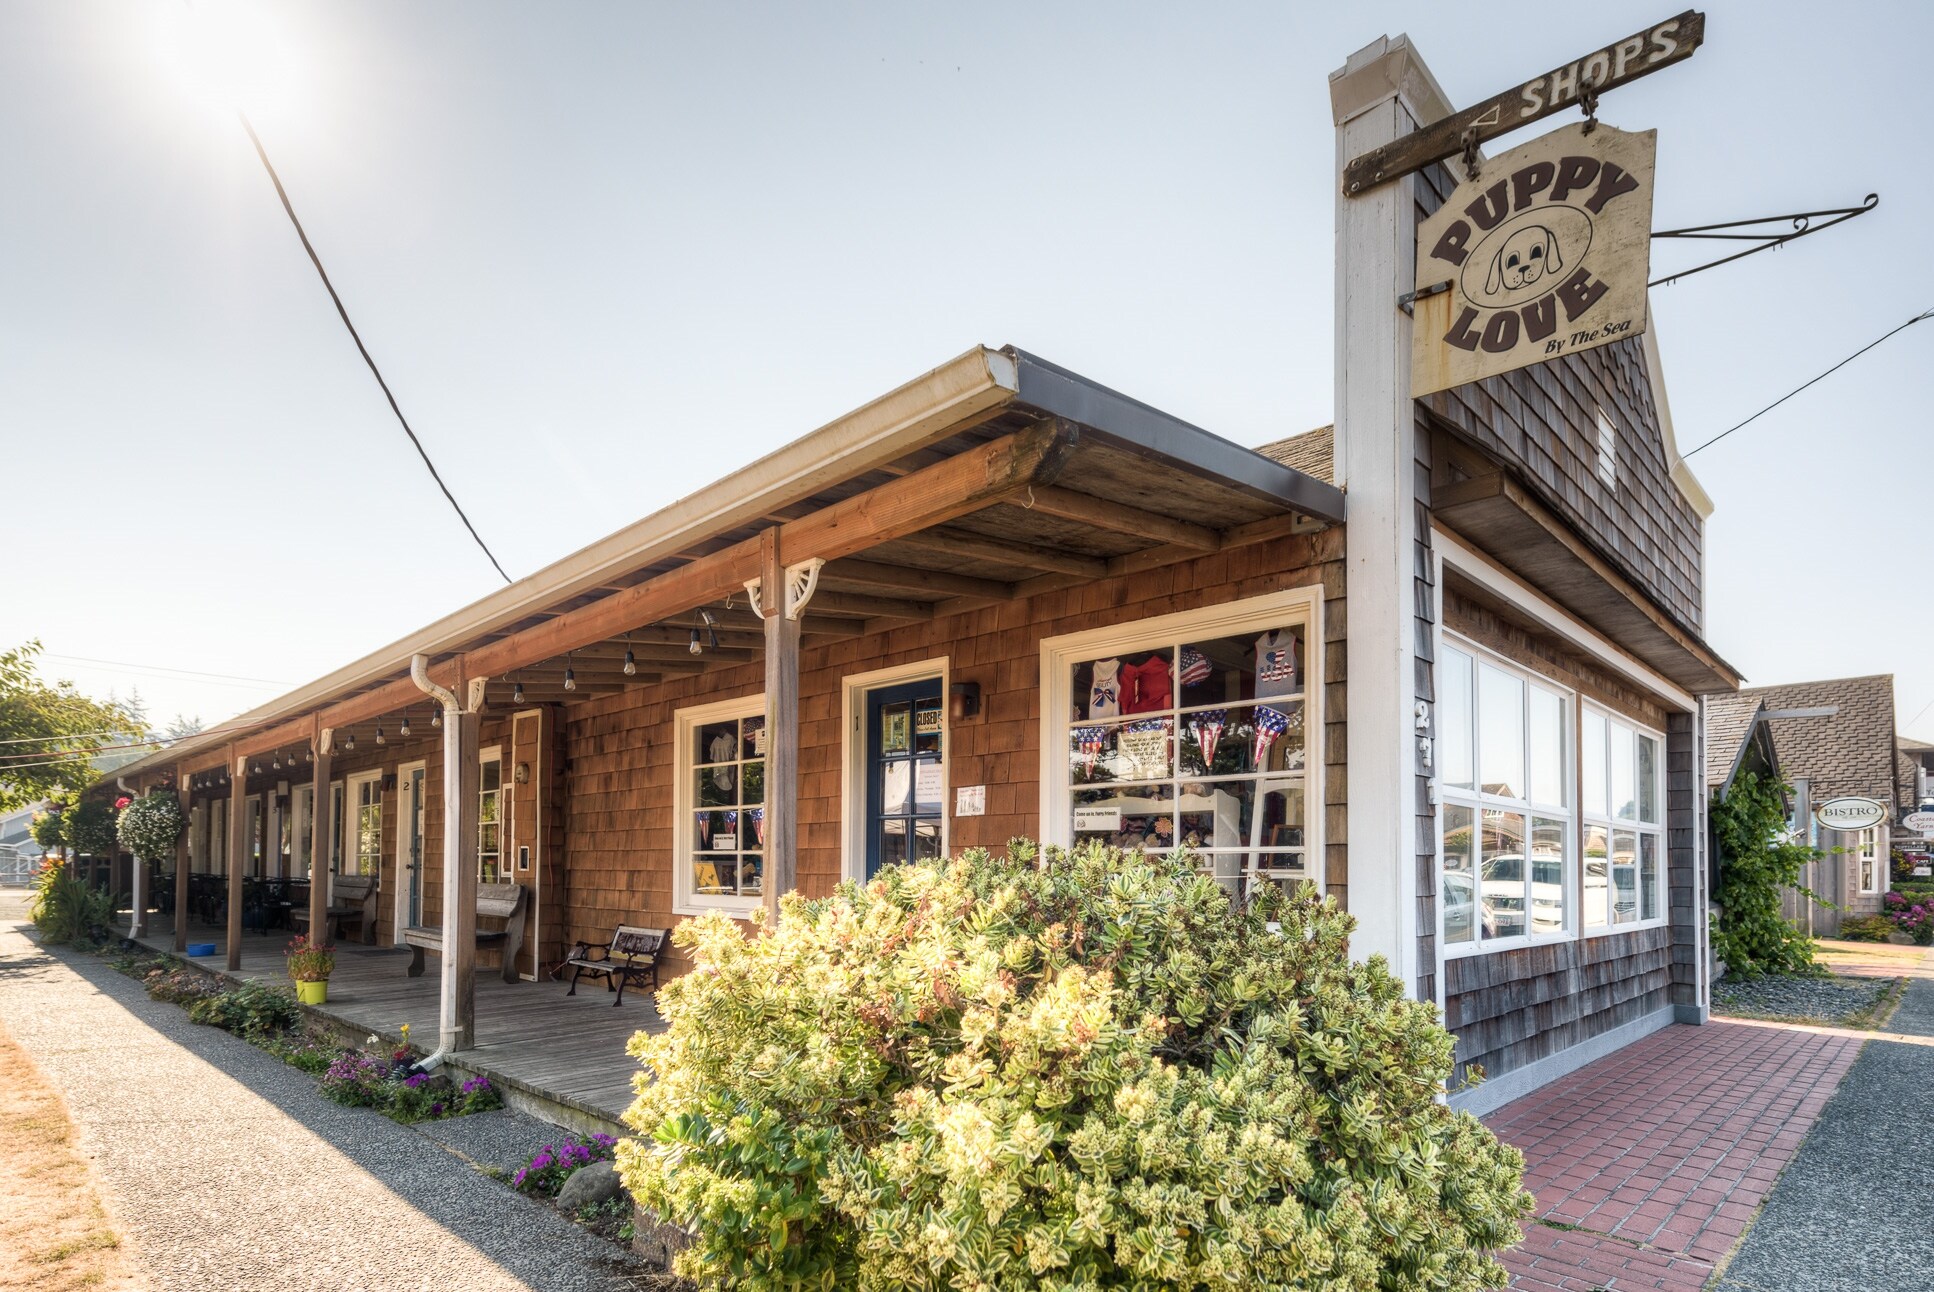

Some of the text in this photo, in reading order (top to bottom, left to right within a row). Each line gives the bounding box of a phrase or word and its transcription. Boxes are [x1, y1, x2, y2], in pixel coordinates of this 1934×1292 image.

[1520, 20, 1680, 118] SHOPS
[1430, 156, 1640, 267] PUPPY
[1442, 267, 1610, 353] LOVE
[1545, 319, 1632, 354] By The Sea
[1260, 662, 1295, 682] USA
[916, 711, 938, 726] CLOSED
[403, 781, 410, 791] 2
[1824, 807, 1878, 816] BISTRO
